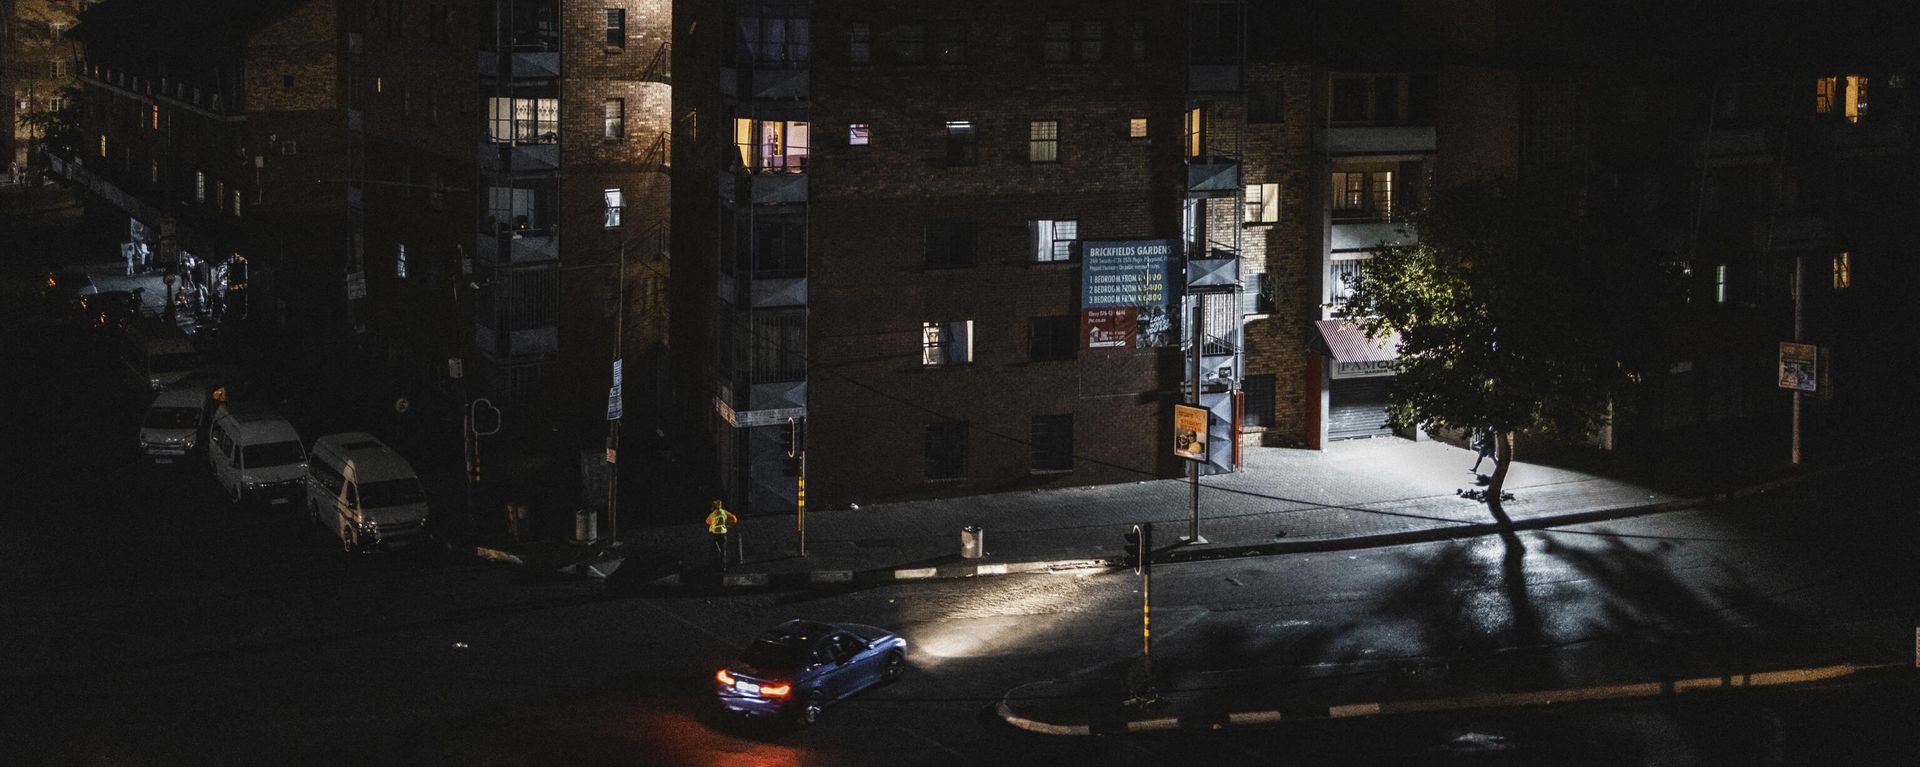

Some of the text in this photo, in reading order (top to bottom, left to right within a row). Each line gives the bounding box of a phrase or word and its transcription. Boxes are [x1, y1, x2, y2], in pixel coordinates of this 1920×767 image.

[1090, 246, 1172, 257] BRICKFIELDS GARDENS
[1089, 276, 1093, 284] 1
[1095, 274, 1121, 284] BEDROOM
[1122, 274, 1137, 282] FROM
[1089, 286, 1093, 294] 2
[1094, 284, 1121, 294] BEDROOM
[1122, 284, 1137, 293] FROM
[1089, 296, 1093, 304] 3
[1094, 295, 1121, 304] BEDROOM
[1121, 294, 1137, 303] FROM
[1341, 360, 1394, 371] FAMOU
